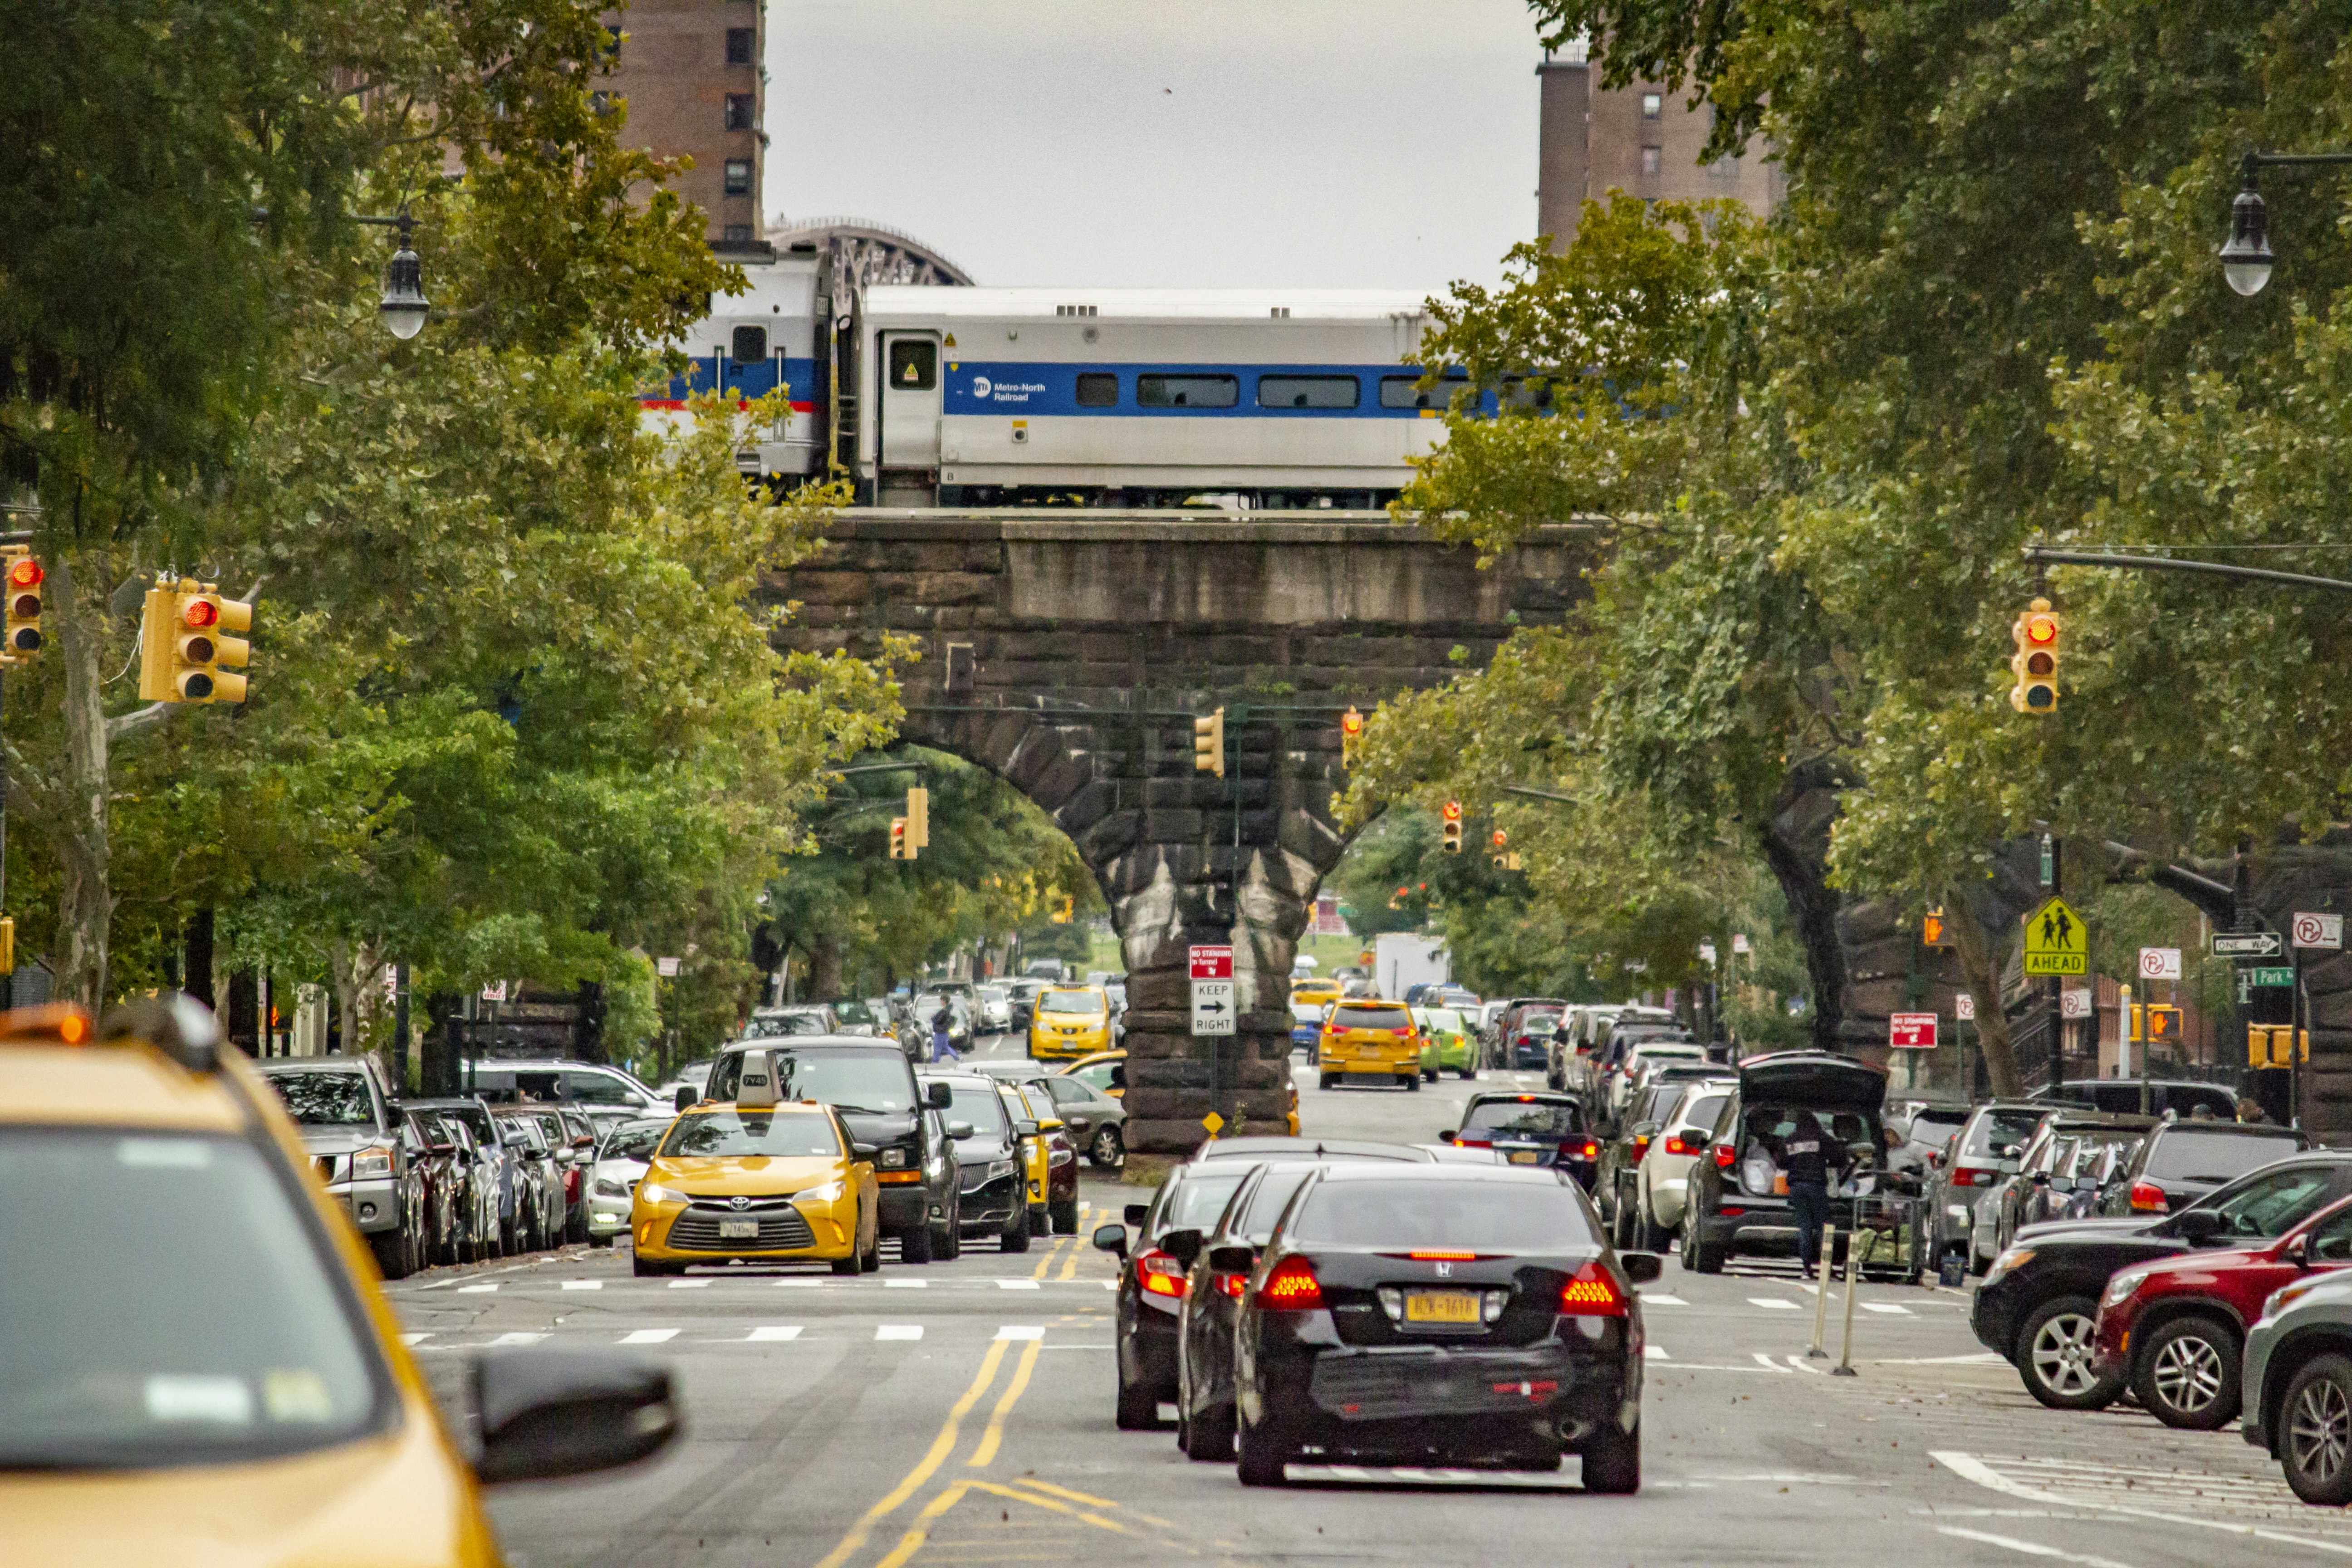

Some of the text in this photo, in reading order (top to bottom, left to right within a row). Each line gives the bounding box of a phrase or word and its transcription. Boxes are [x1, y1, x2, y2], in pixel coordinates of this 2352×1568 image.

[995, 383, 1045, 392] Metro-North
[2219, 940, 2272, 949] ONE WAY
[2032, 956, 2081, 970] AHEAD
[2261, 971, 2283, 983] Park
[1199, 985, 1228, 995] KEEP
[1197, 1019, 1230, 1030] RIGHT
